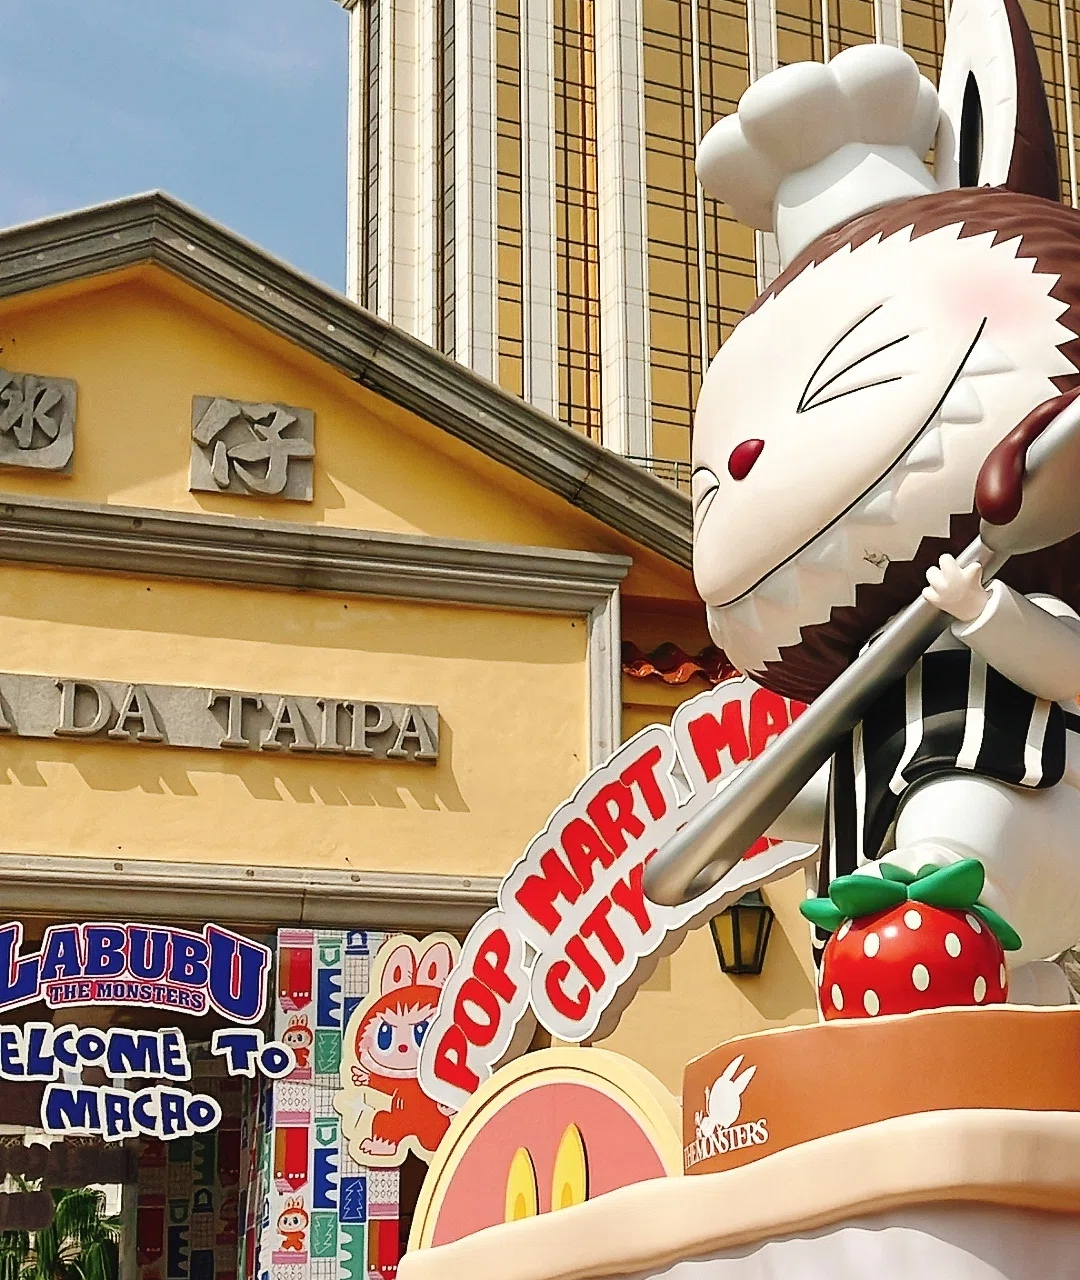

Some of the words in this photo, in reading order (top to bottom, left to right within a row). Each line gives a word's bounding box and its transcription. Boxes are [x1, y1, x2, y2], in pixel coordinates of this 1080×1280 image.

[53, 678, 163, 742] DA
[207, 689, 439, 761] TAIPA
[434, 928, 518, 1095] POP
[514, 745, 667, 936] MART
[688, 687, 810, 783] MA
[0, 925, 267, 1021] LABUBU
[51, 984, 90, 1003] THE
[99, 983, 205, 1010] MONSTERS
[0, 1028, 187, 1076] ELCOME
[214, 1033, 290, 1071] TO
[45, 1087, 216, 1137] MACAO
